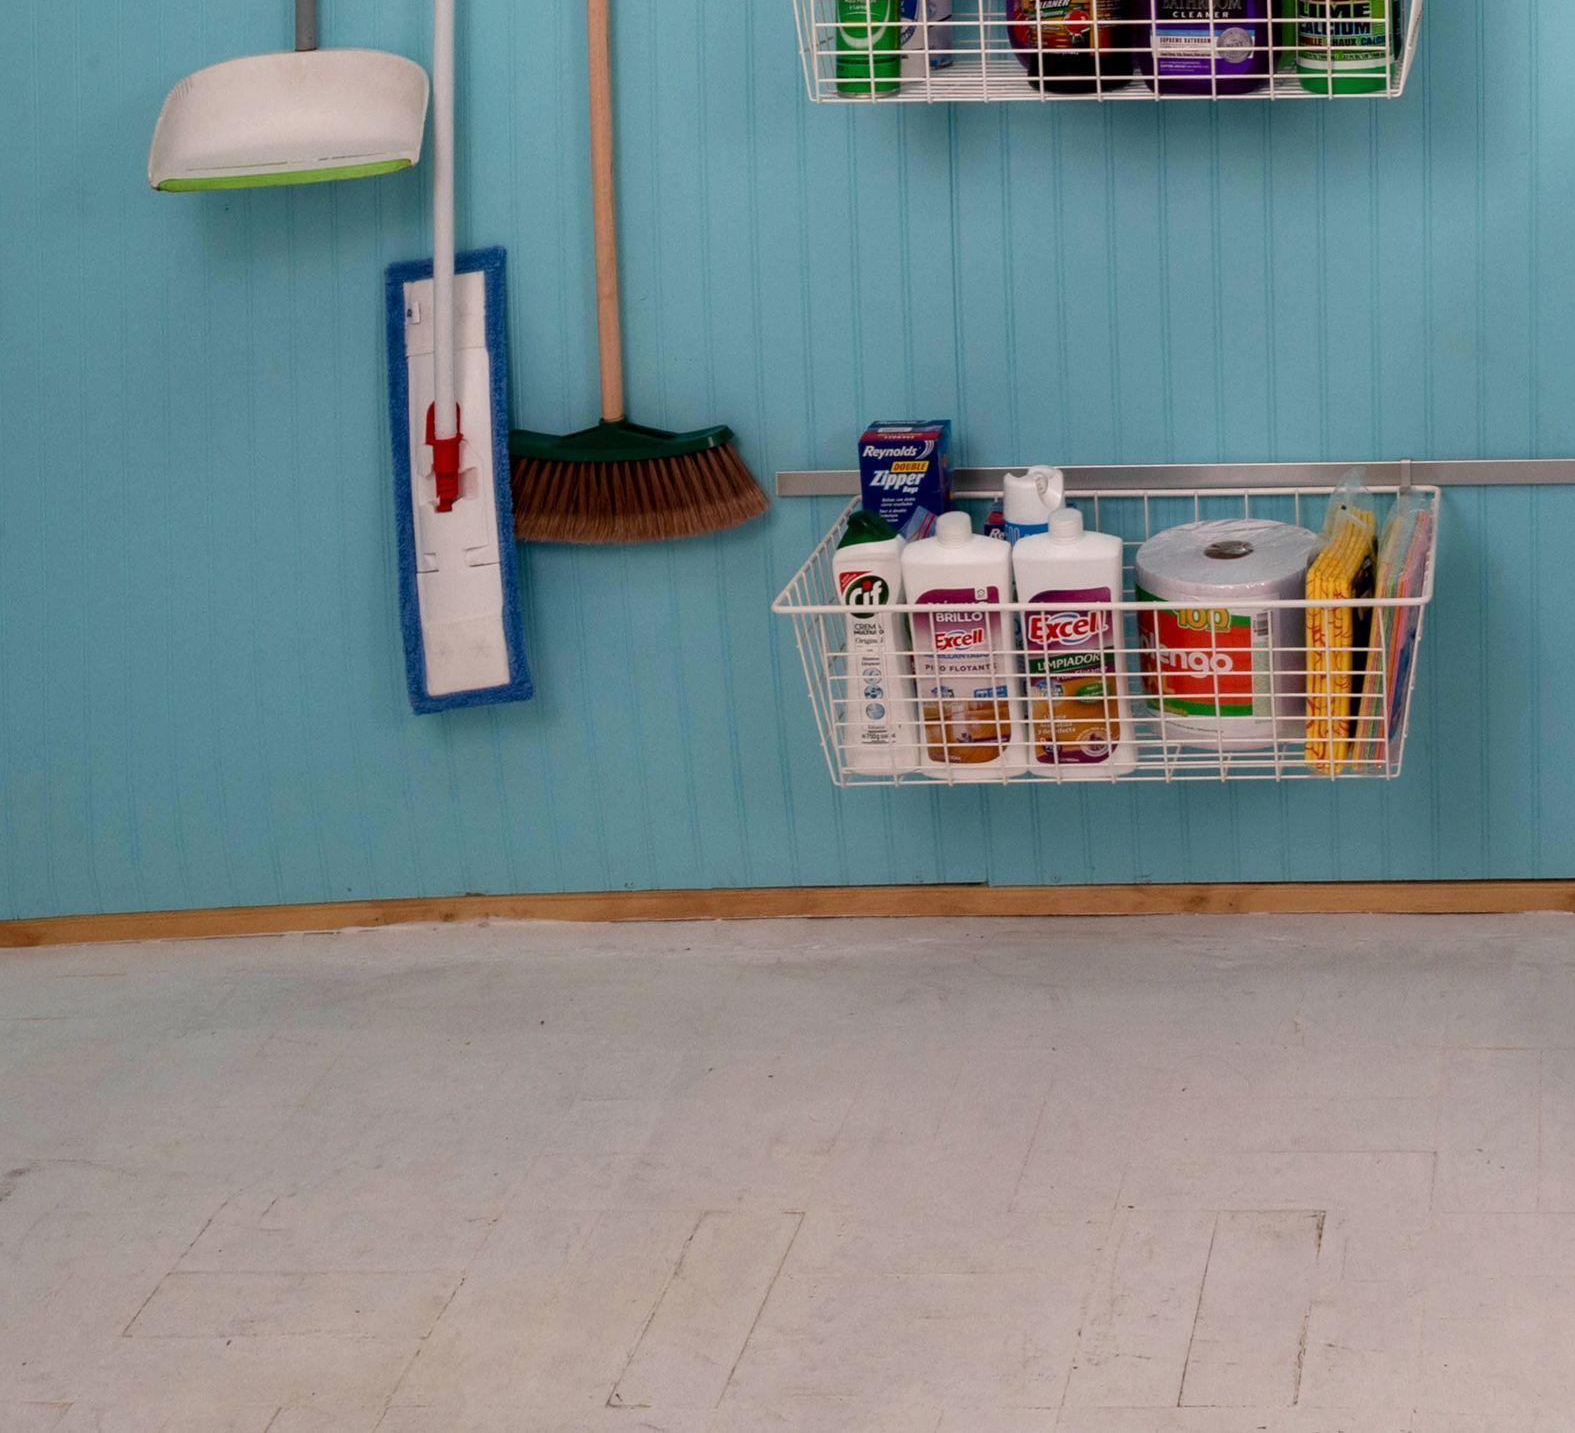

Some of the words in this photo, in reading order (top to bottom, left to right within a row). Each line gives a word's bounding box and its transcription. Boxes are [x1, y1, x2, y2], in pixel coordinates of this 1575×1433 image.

[1172, 11, 1230, 19] CLEANER
[1298, 2, 1371, 19] LIME
[1331, 37, 1357, 46] HAUX
[862, 445, 918, 460] Reynolds
[893, 462, 926, 471] DOUBLE
[869, 470, 926, 491] Zipper
[848, 578, 883, 611] Cif
[935, 611, 984, 623] BRILLO
[934, 628, 984, 651] Excell
[925, 664, 946, 672] PIO
